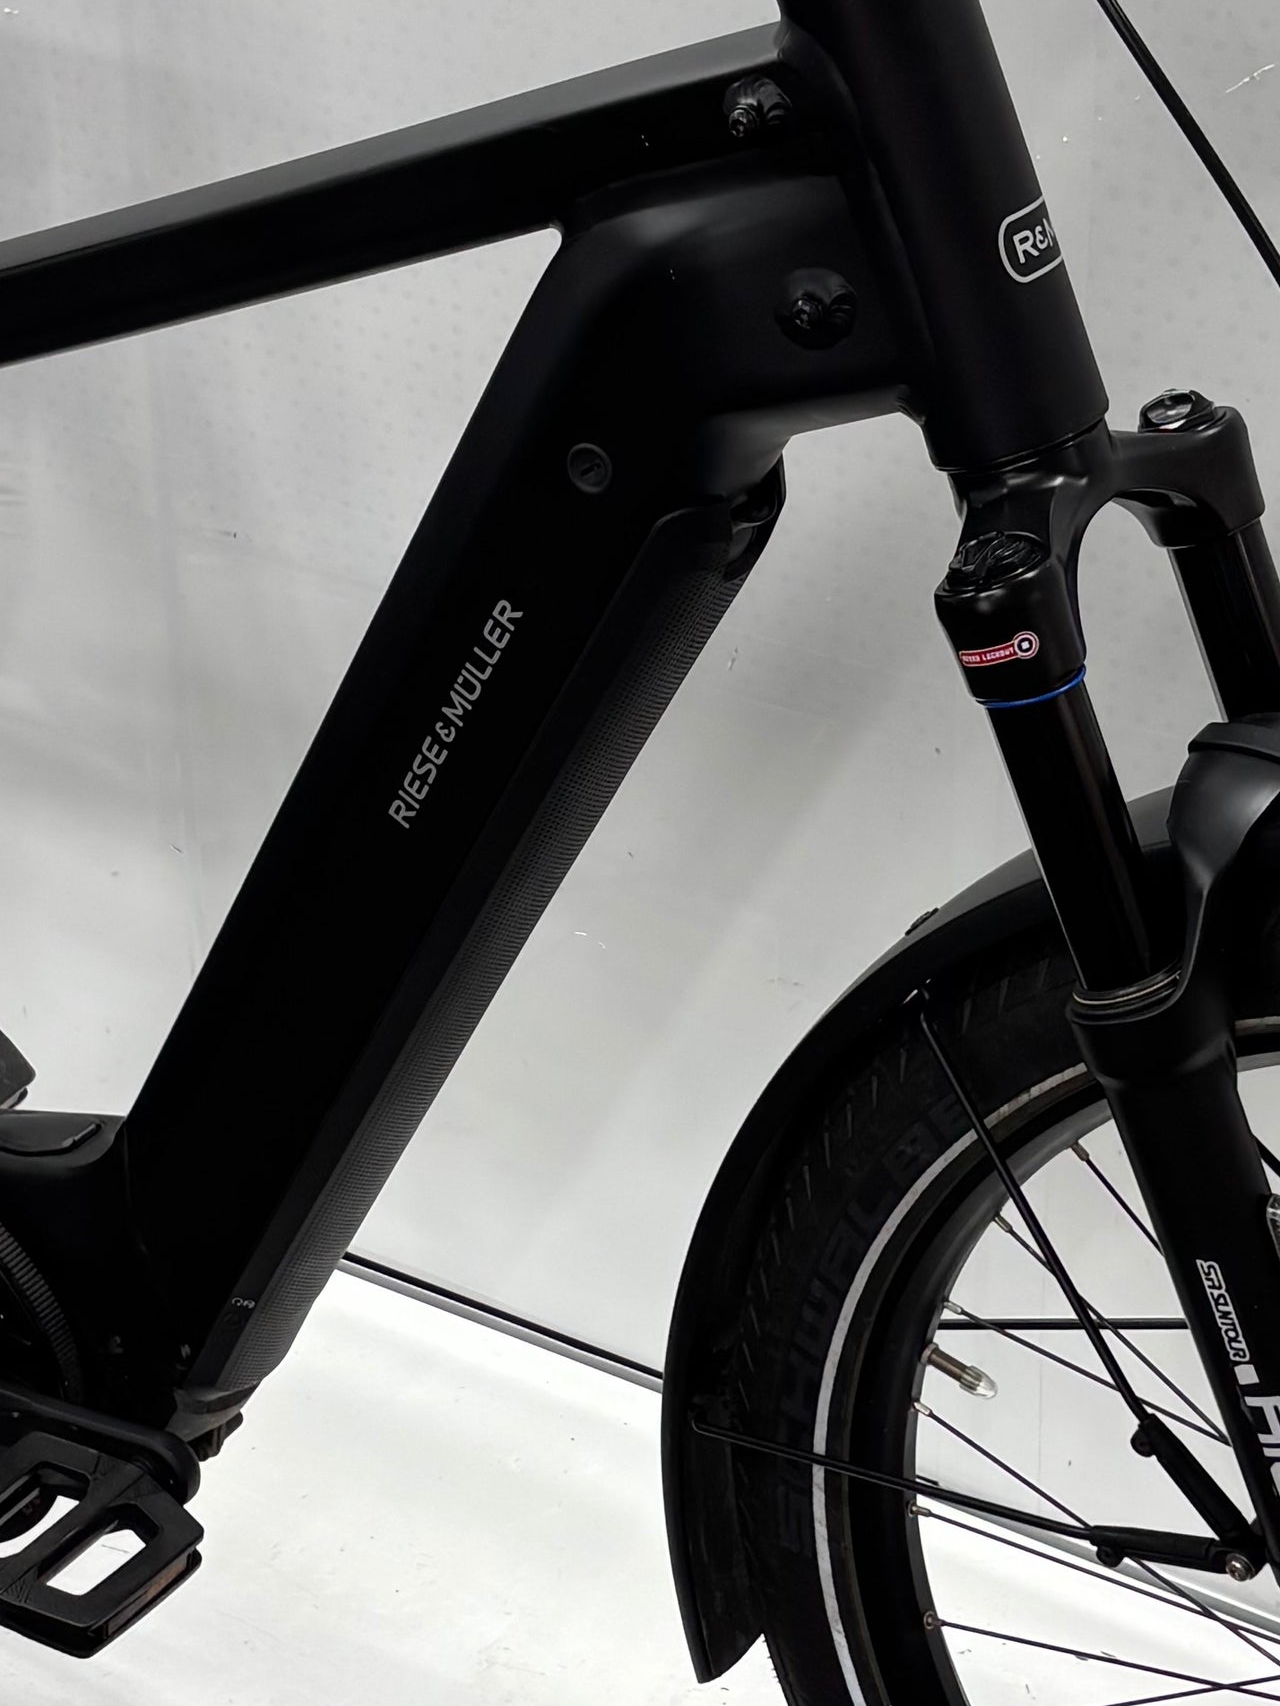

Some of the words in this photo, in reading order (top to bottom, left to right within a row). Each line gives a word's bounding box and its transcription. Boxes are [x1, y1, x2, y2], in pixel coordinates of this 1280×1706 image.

[440, 598, 525, 728] MÜLLER
[434, 721, 457, 743] &
[388, 735, 449, 830] RIESE
[1197, 1259, 1227, 1293] SR
[1209, 1290, 1251, 1363] SUNTOUR
